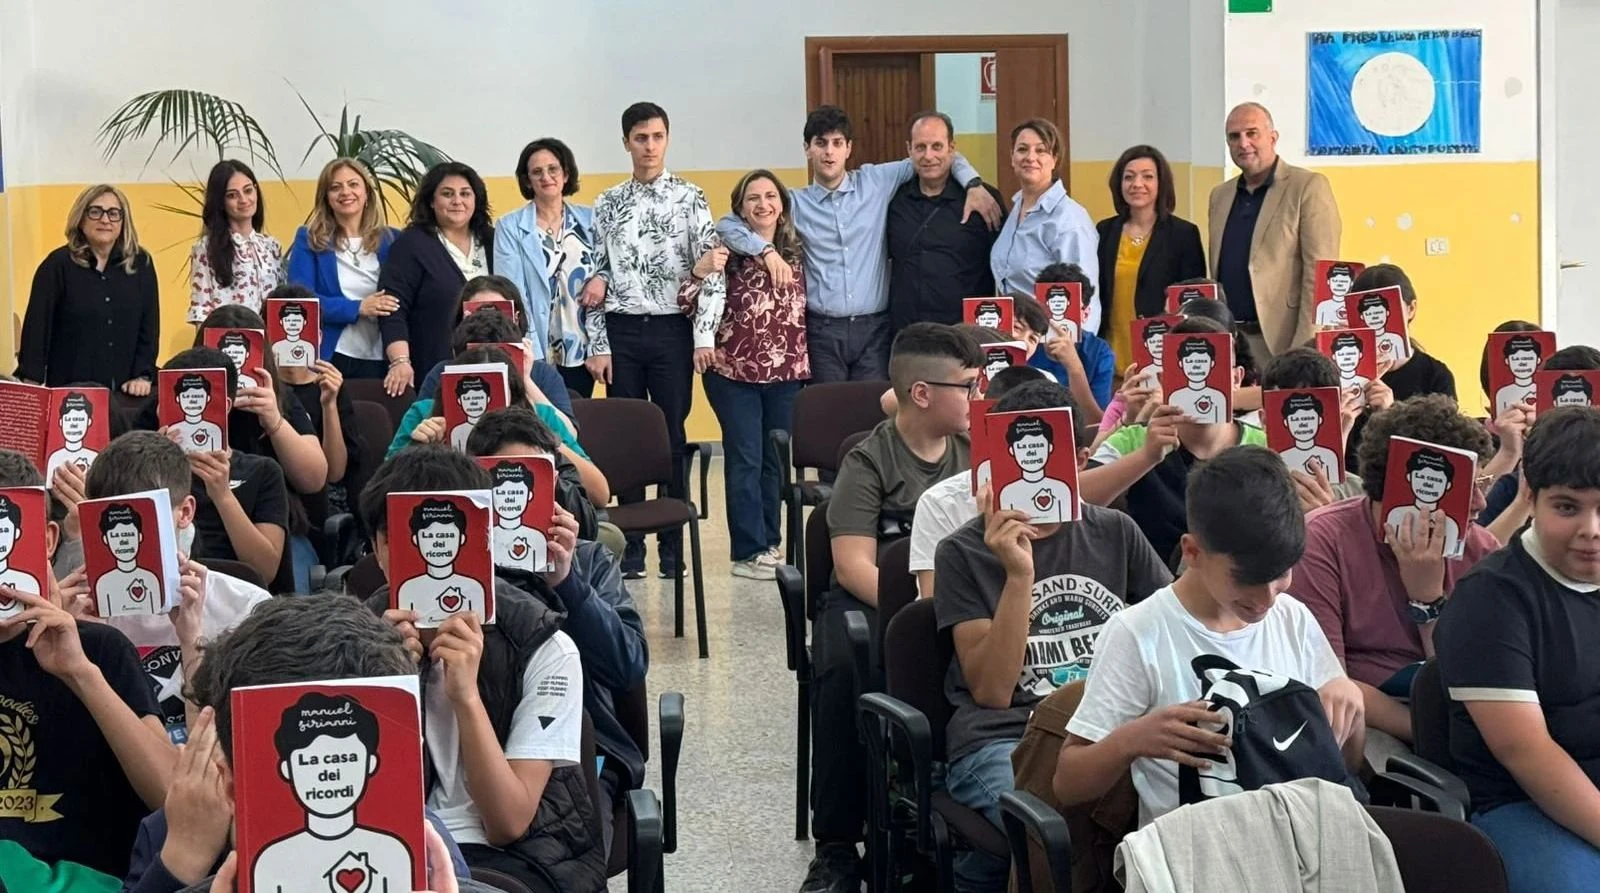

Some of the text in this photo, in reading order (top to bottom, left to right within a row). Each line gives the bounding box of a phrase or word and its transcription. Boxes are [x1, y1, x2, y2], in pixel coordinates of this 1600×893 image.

[1041, 605, 1084, 626] Original
[301, 702, 353, 717] manuel
[298, 752, 358, 766] La casa
[318, 770, 340, 782] dei
[306, 785, 354, 800] ricordi
